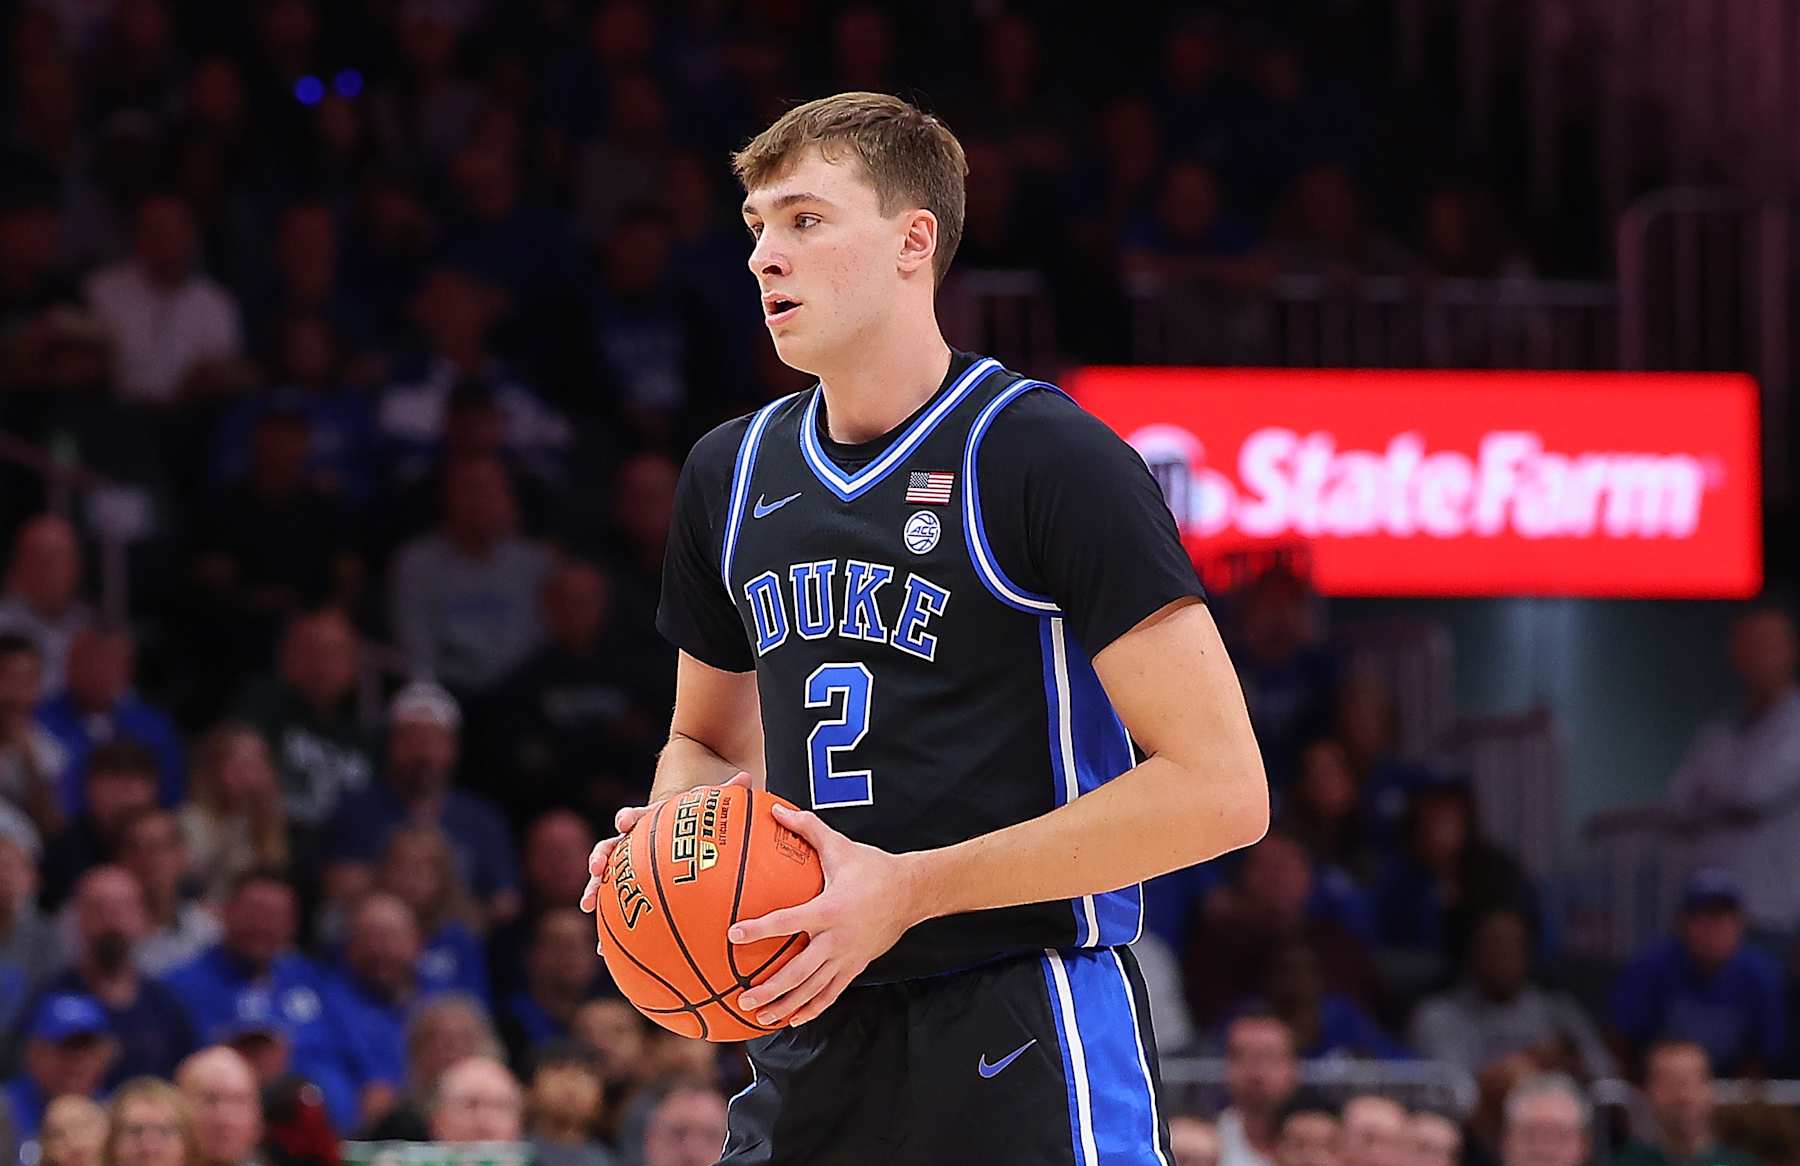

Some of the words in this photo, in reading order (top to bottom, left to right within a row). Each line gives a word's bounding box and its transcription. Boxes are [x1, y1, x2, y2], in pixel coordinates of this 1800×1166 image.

[910, 525, 939, 537] ACC
[744, 558, 952, 663] DUKE
[804, 661, 874, 810] 2
[671, 789, 704, 885] LEGAC
